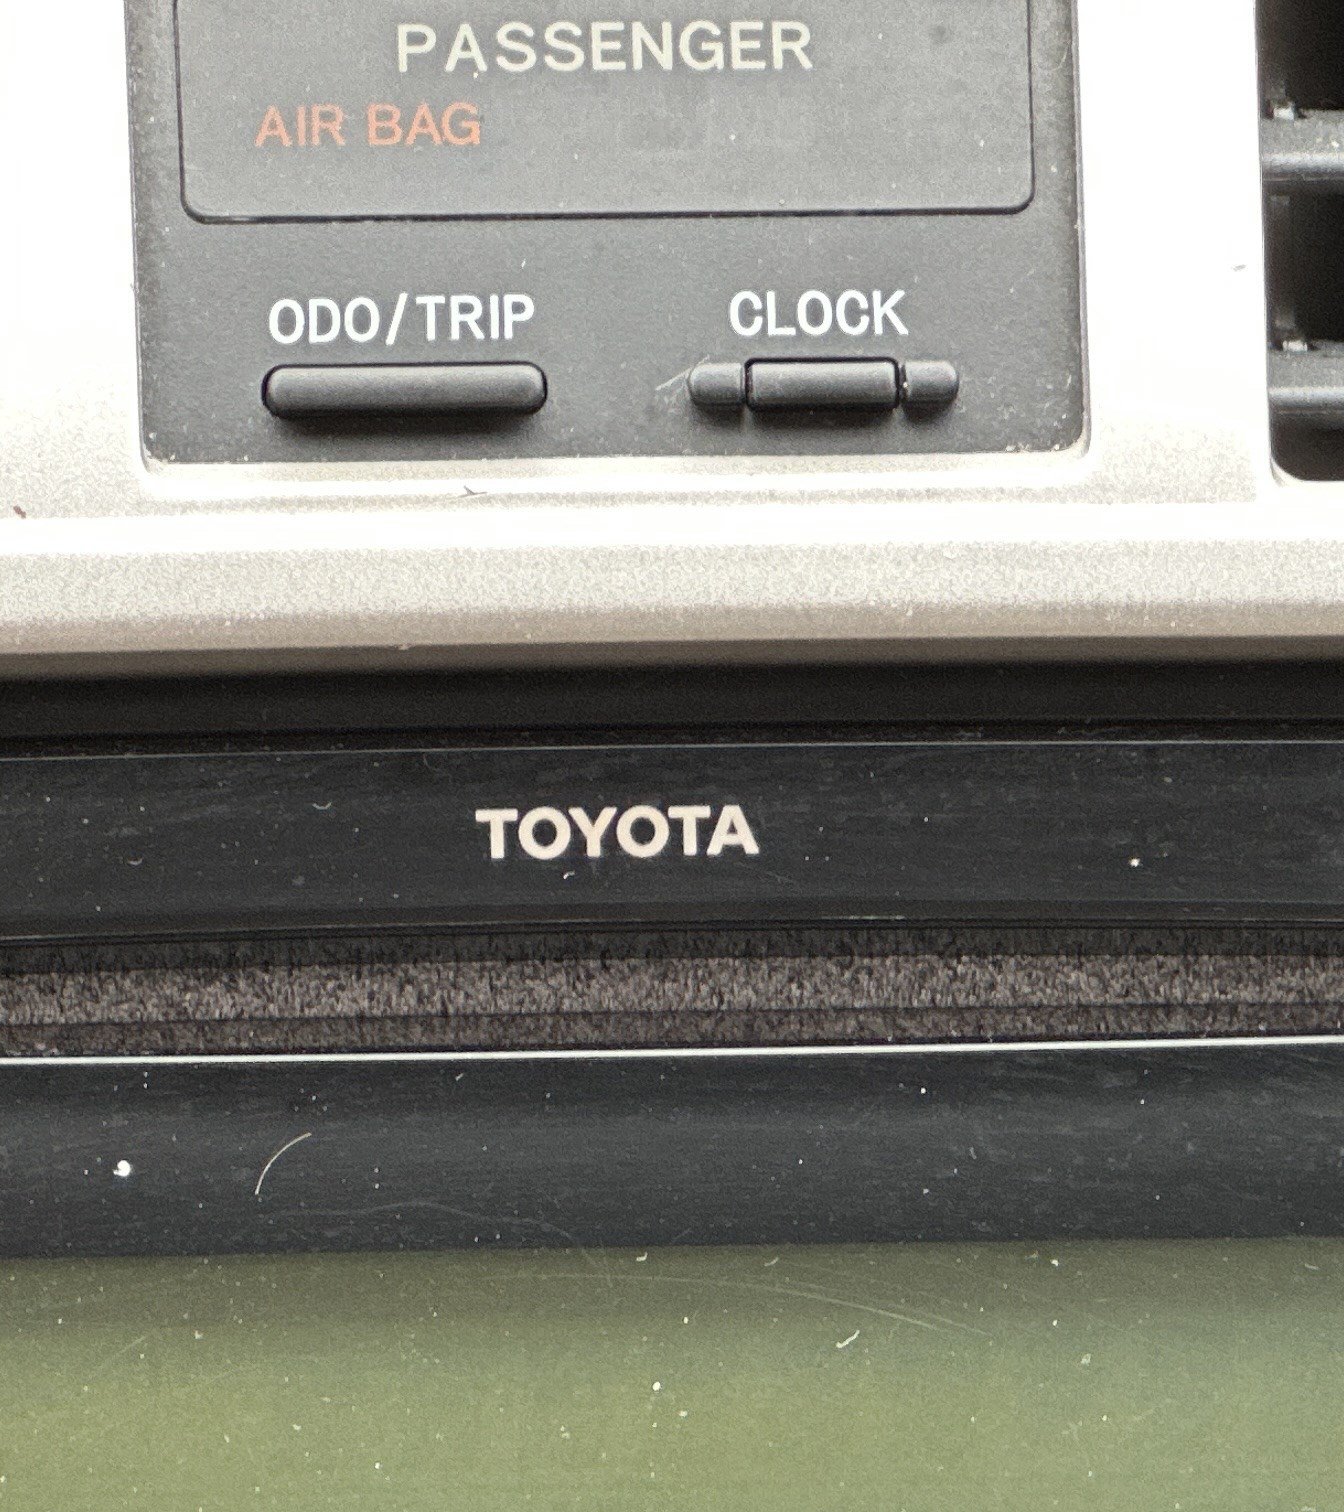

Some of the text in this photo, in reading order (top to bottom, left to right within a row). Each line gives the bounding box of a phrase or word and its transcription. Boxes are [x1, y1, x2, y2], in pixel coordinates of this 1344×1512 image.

[397, 19, 813, 73] PASSENGER
[256, 101, 483, 148] AIR BAG
[268, 293, 535, 345] ODO/TRIP
[728, 289, 909, 338] CLOCK
[475, 804, 759, 859] TOYOTA
